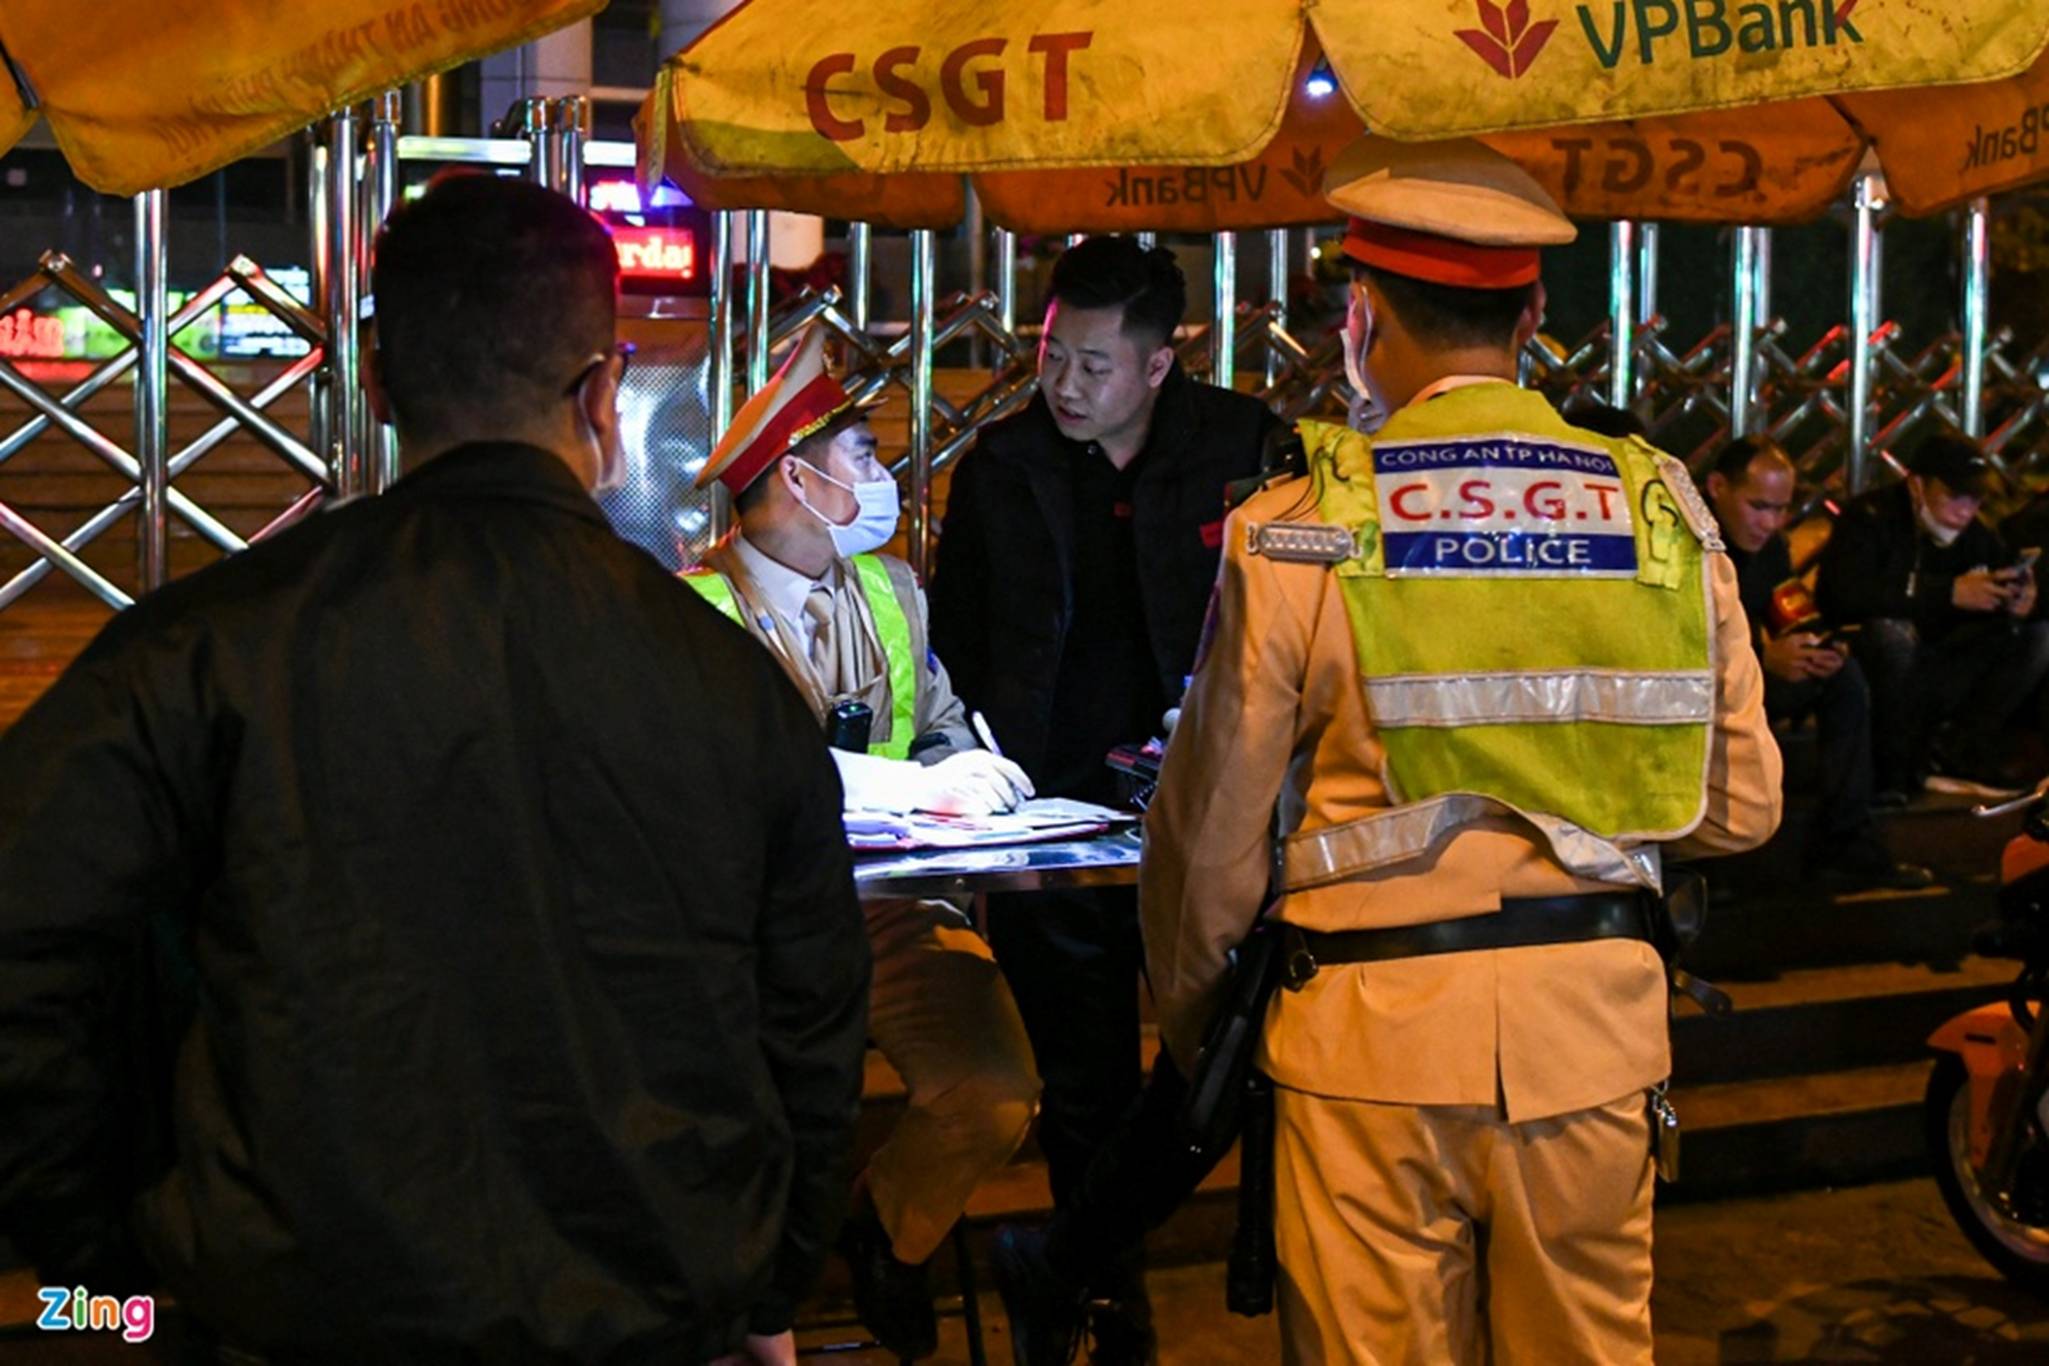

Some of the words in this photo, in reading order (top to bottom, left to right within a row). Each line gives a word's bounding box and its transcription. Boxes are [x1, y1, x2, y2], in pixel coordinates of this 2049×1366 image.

[1576, 0, 1863, 69] VPBank
[806, 31, 1093, 142] CSGT
[1464, 446, 1500, 460] AN
[1504, 445, 1532, 461] TP
[1389, 480, 1619, 522] C.S.G.T
[1435, 537, 1592, 565] POLICE
